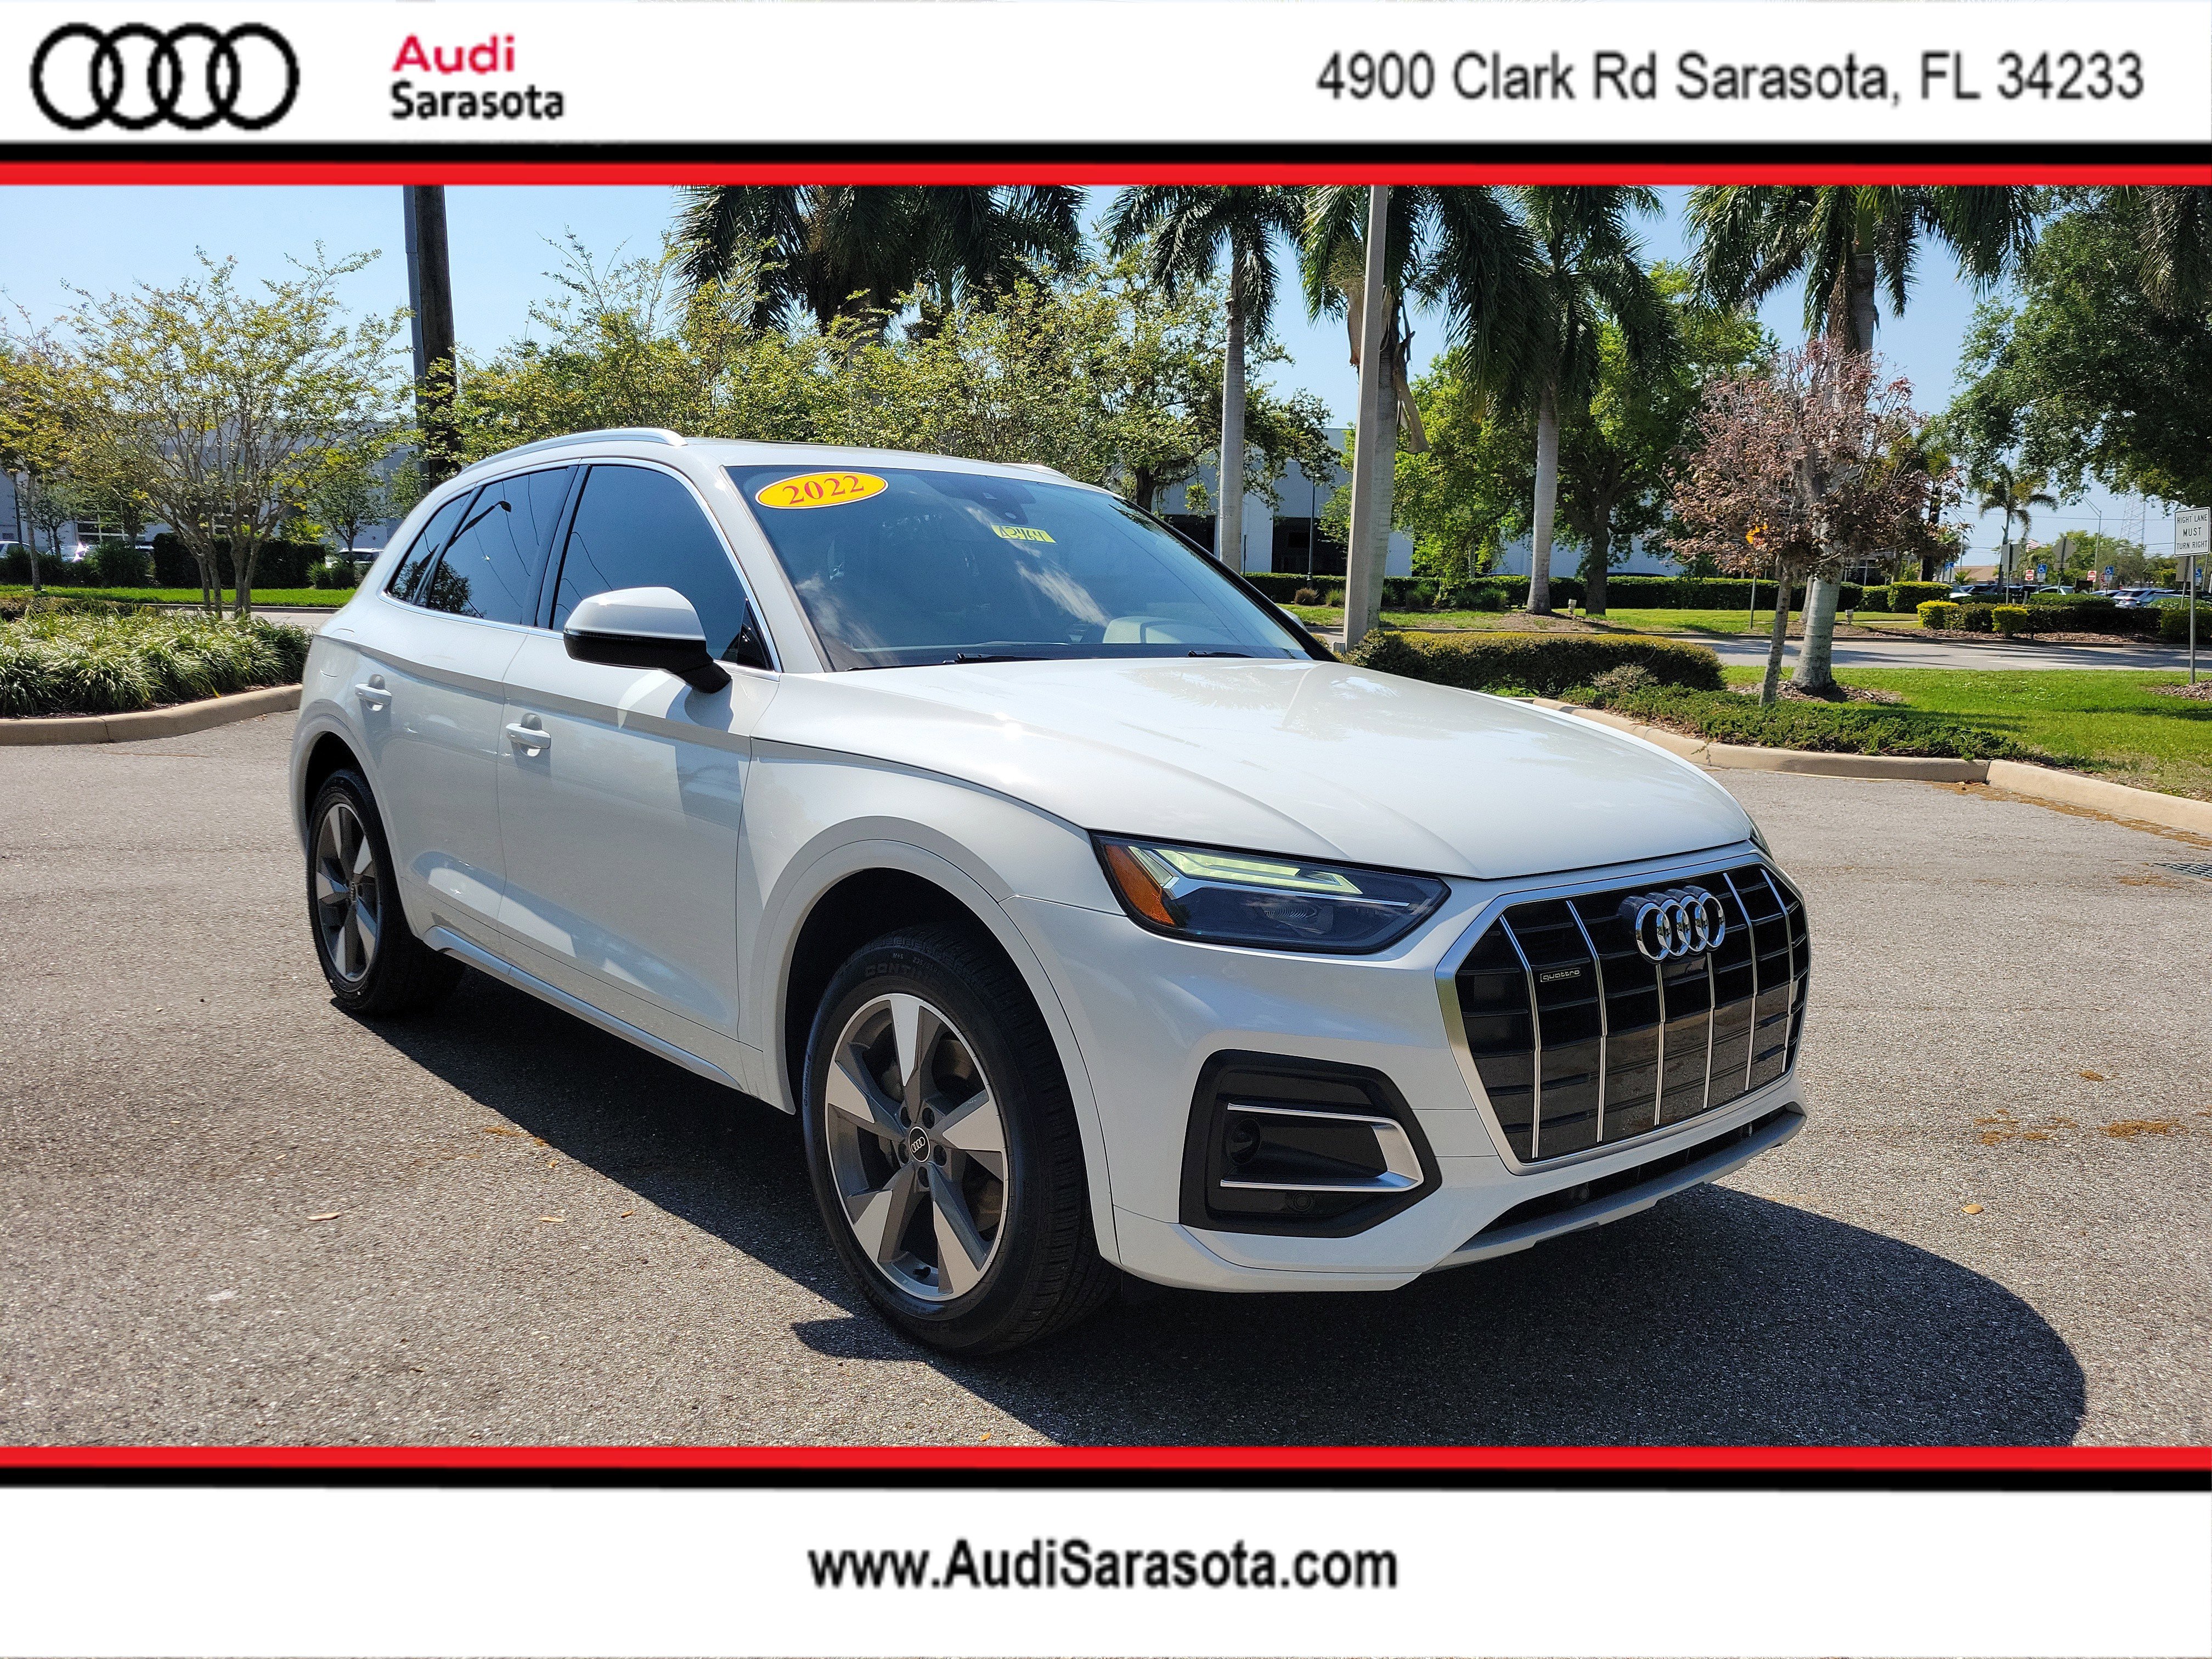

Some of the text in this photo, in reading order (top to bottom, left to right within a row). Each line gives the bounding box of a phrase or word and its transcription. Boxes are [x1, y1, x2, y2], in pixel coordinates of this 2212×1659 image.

[782, 475, 865, 505] 2022
[2177, 514, 2208, 524] RIGHT LANE
[2183, 527, 2202, 537] MUST
[2176, 540, 2208, 550] TURN RIGHT
[1543, 969, 1580, 981] quattro
